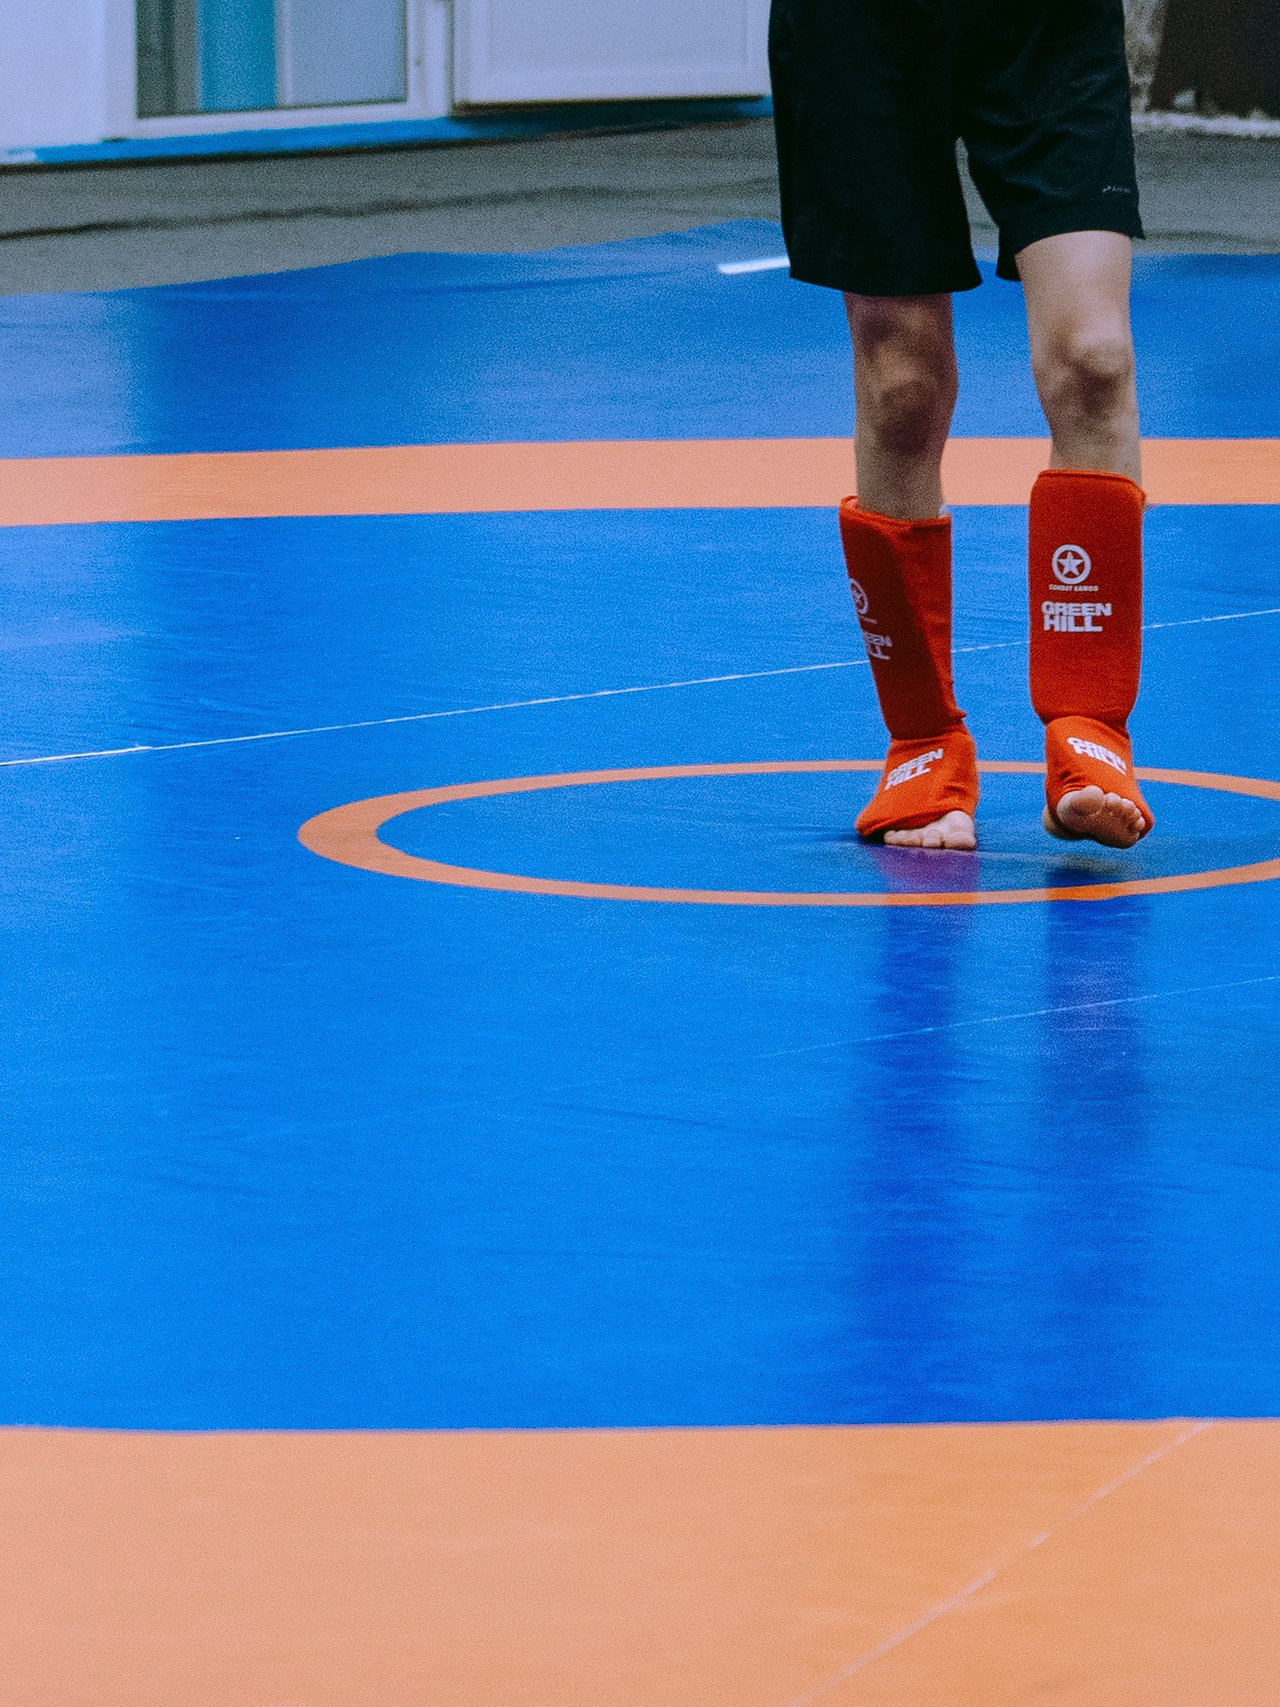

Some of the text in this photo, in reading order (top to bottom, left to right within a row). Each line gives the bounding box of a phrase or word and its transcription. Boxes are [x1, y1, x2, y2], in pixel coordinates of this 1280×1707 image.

[1041, 600, 1112, 617] GREEN
[1043, 614, 1103, 632] HILL
[887, 748, 944, 783] GREEN
[884, 764, 931, 791] HILL
